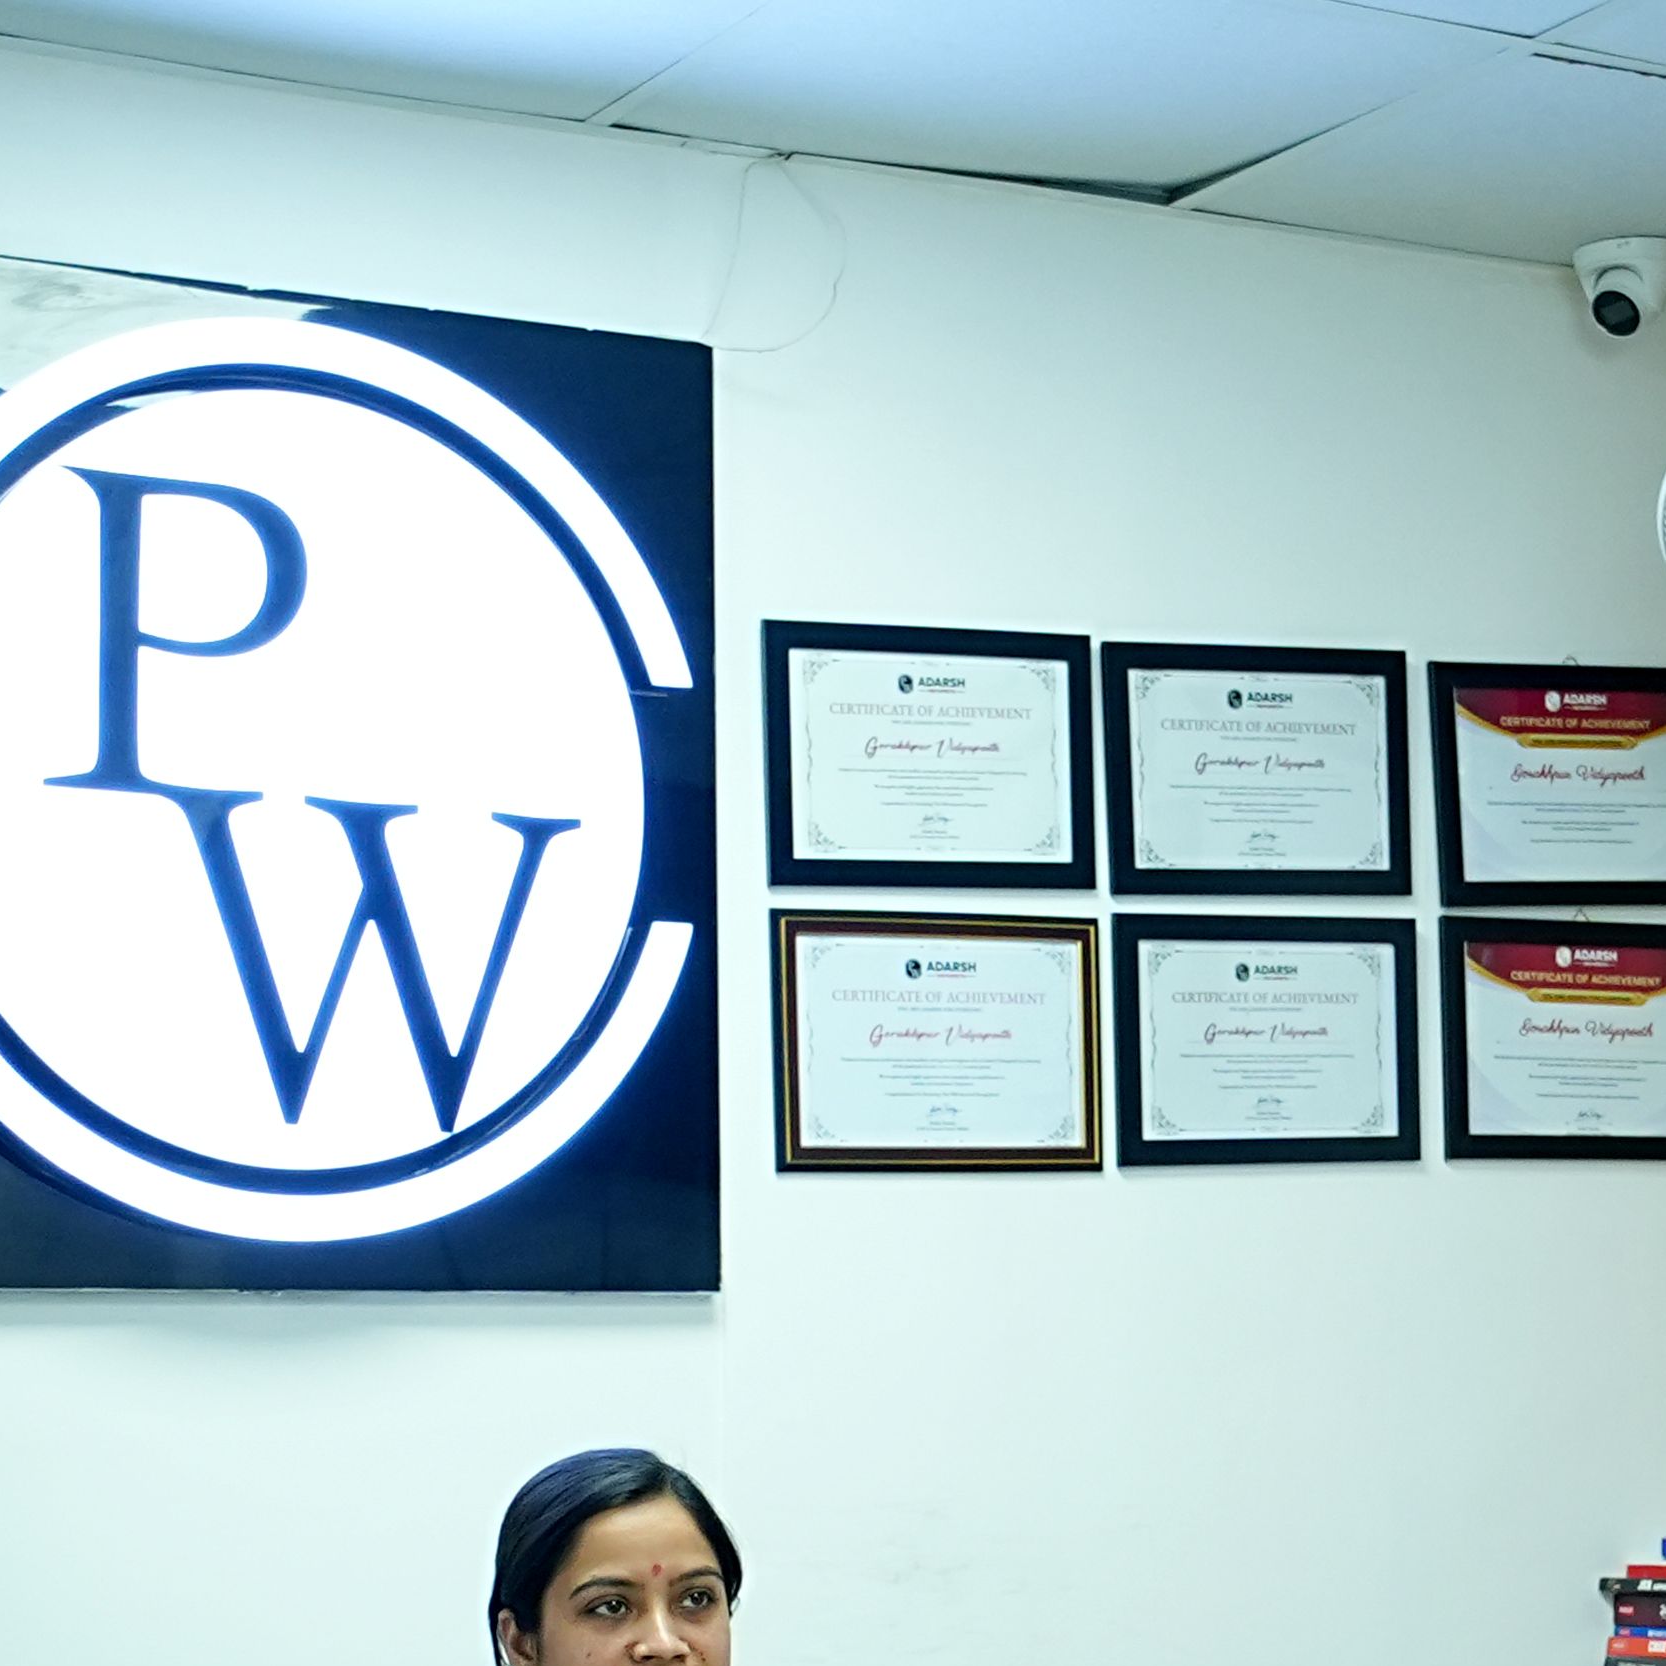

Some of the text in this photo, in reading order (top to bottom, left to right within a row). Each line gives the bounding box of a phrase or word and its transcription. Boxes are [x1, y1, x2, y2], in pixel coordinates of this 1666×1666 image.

[918, 677, 965, 688] ADARSH
[829, 702, 1032, 720] CERTIFICATE OF ACHIEVEMENT
[1160, 718, 1357, 736] CERTIFICATE OF ACHIEVEMENT
[927, 961, 976, 973] ADARSH
[1254, 965, 1298, 975] ADARSH
[832, 989, 1047, 1005] CERTIFICATE OF ACHIEVEMENT
[1171, 991, 1359, 1005] CERTIFICATE OF ACHIEVEMENT
